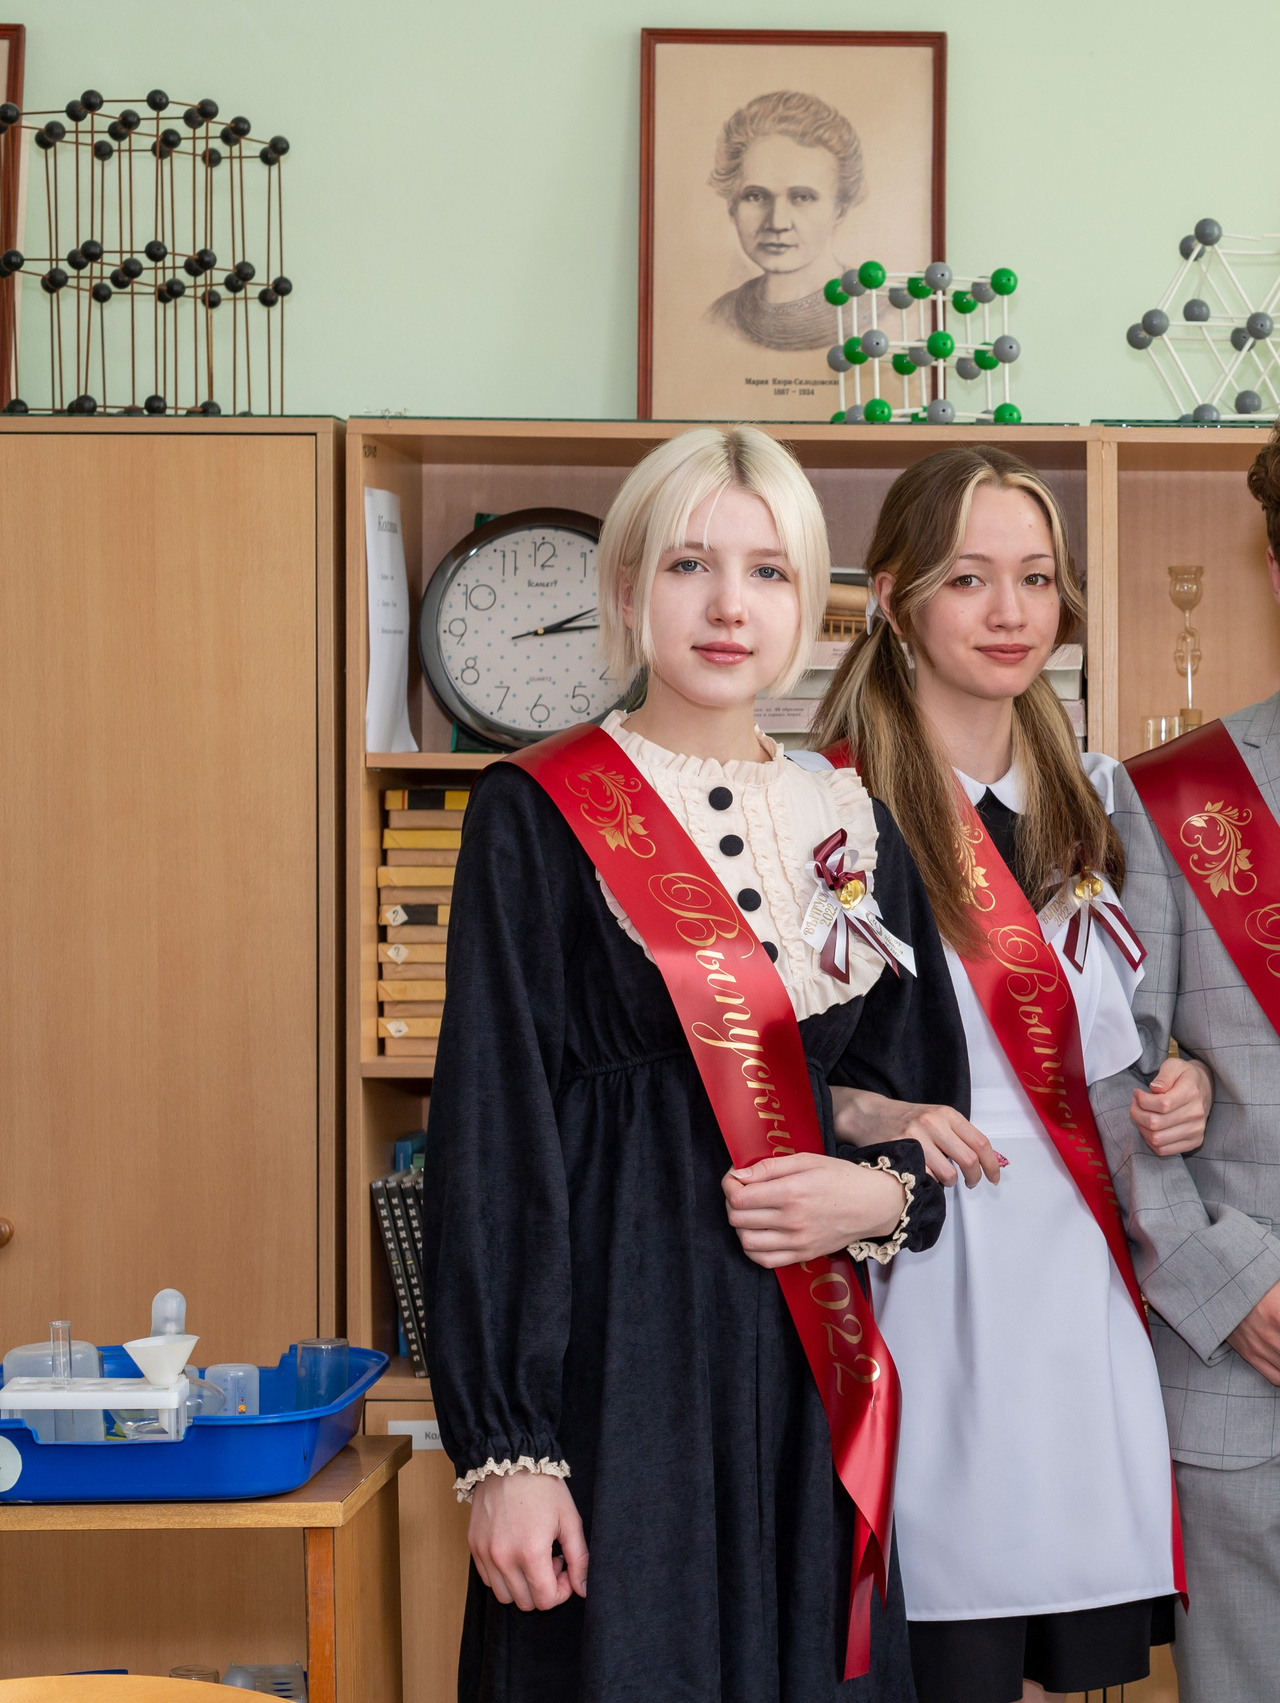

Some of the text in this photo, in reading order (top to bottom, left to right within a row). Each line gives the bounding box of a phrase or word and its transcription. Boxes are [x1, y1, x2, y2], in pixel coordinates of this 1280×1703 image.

[744, 378, 839, 386] Мария Кюри-Склодовска
[500, 550, 518, 577] 11
[531, 541, 557, 568] 12
[463, 584, 497, 611] 10
[448, 617, 467, 646] 9
[461, 657, 480, 686] 8
[494, 686, 511, 713] 7
[530, 694, 550, 724] 6
[570, 685, 591, 714] 5
[820, 903, 838, 928] 2022
[1054, 905, 1073, 928] 2022
[648, 872, 797, 1158] Выпускн
[799, 1255, 881, 1396] 022
